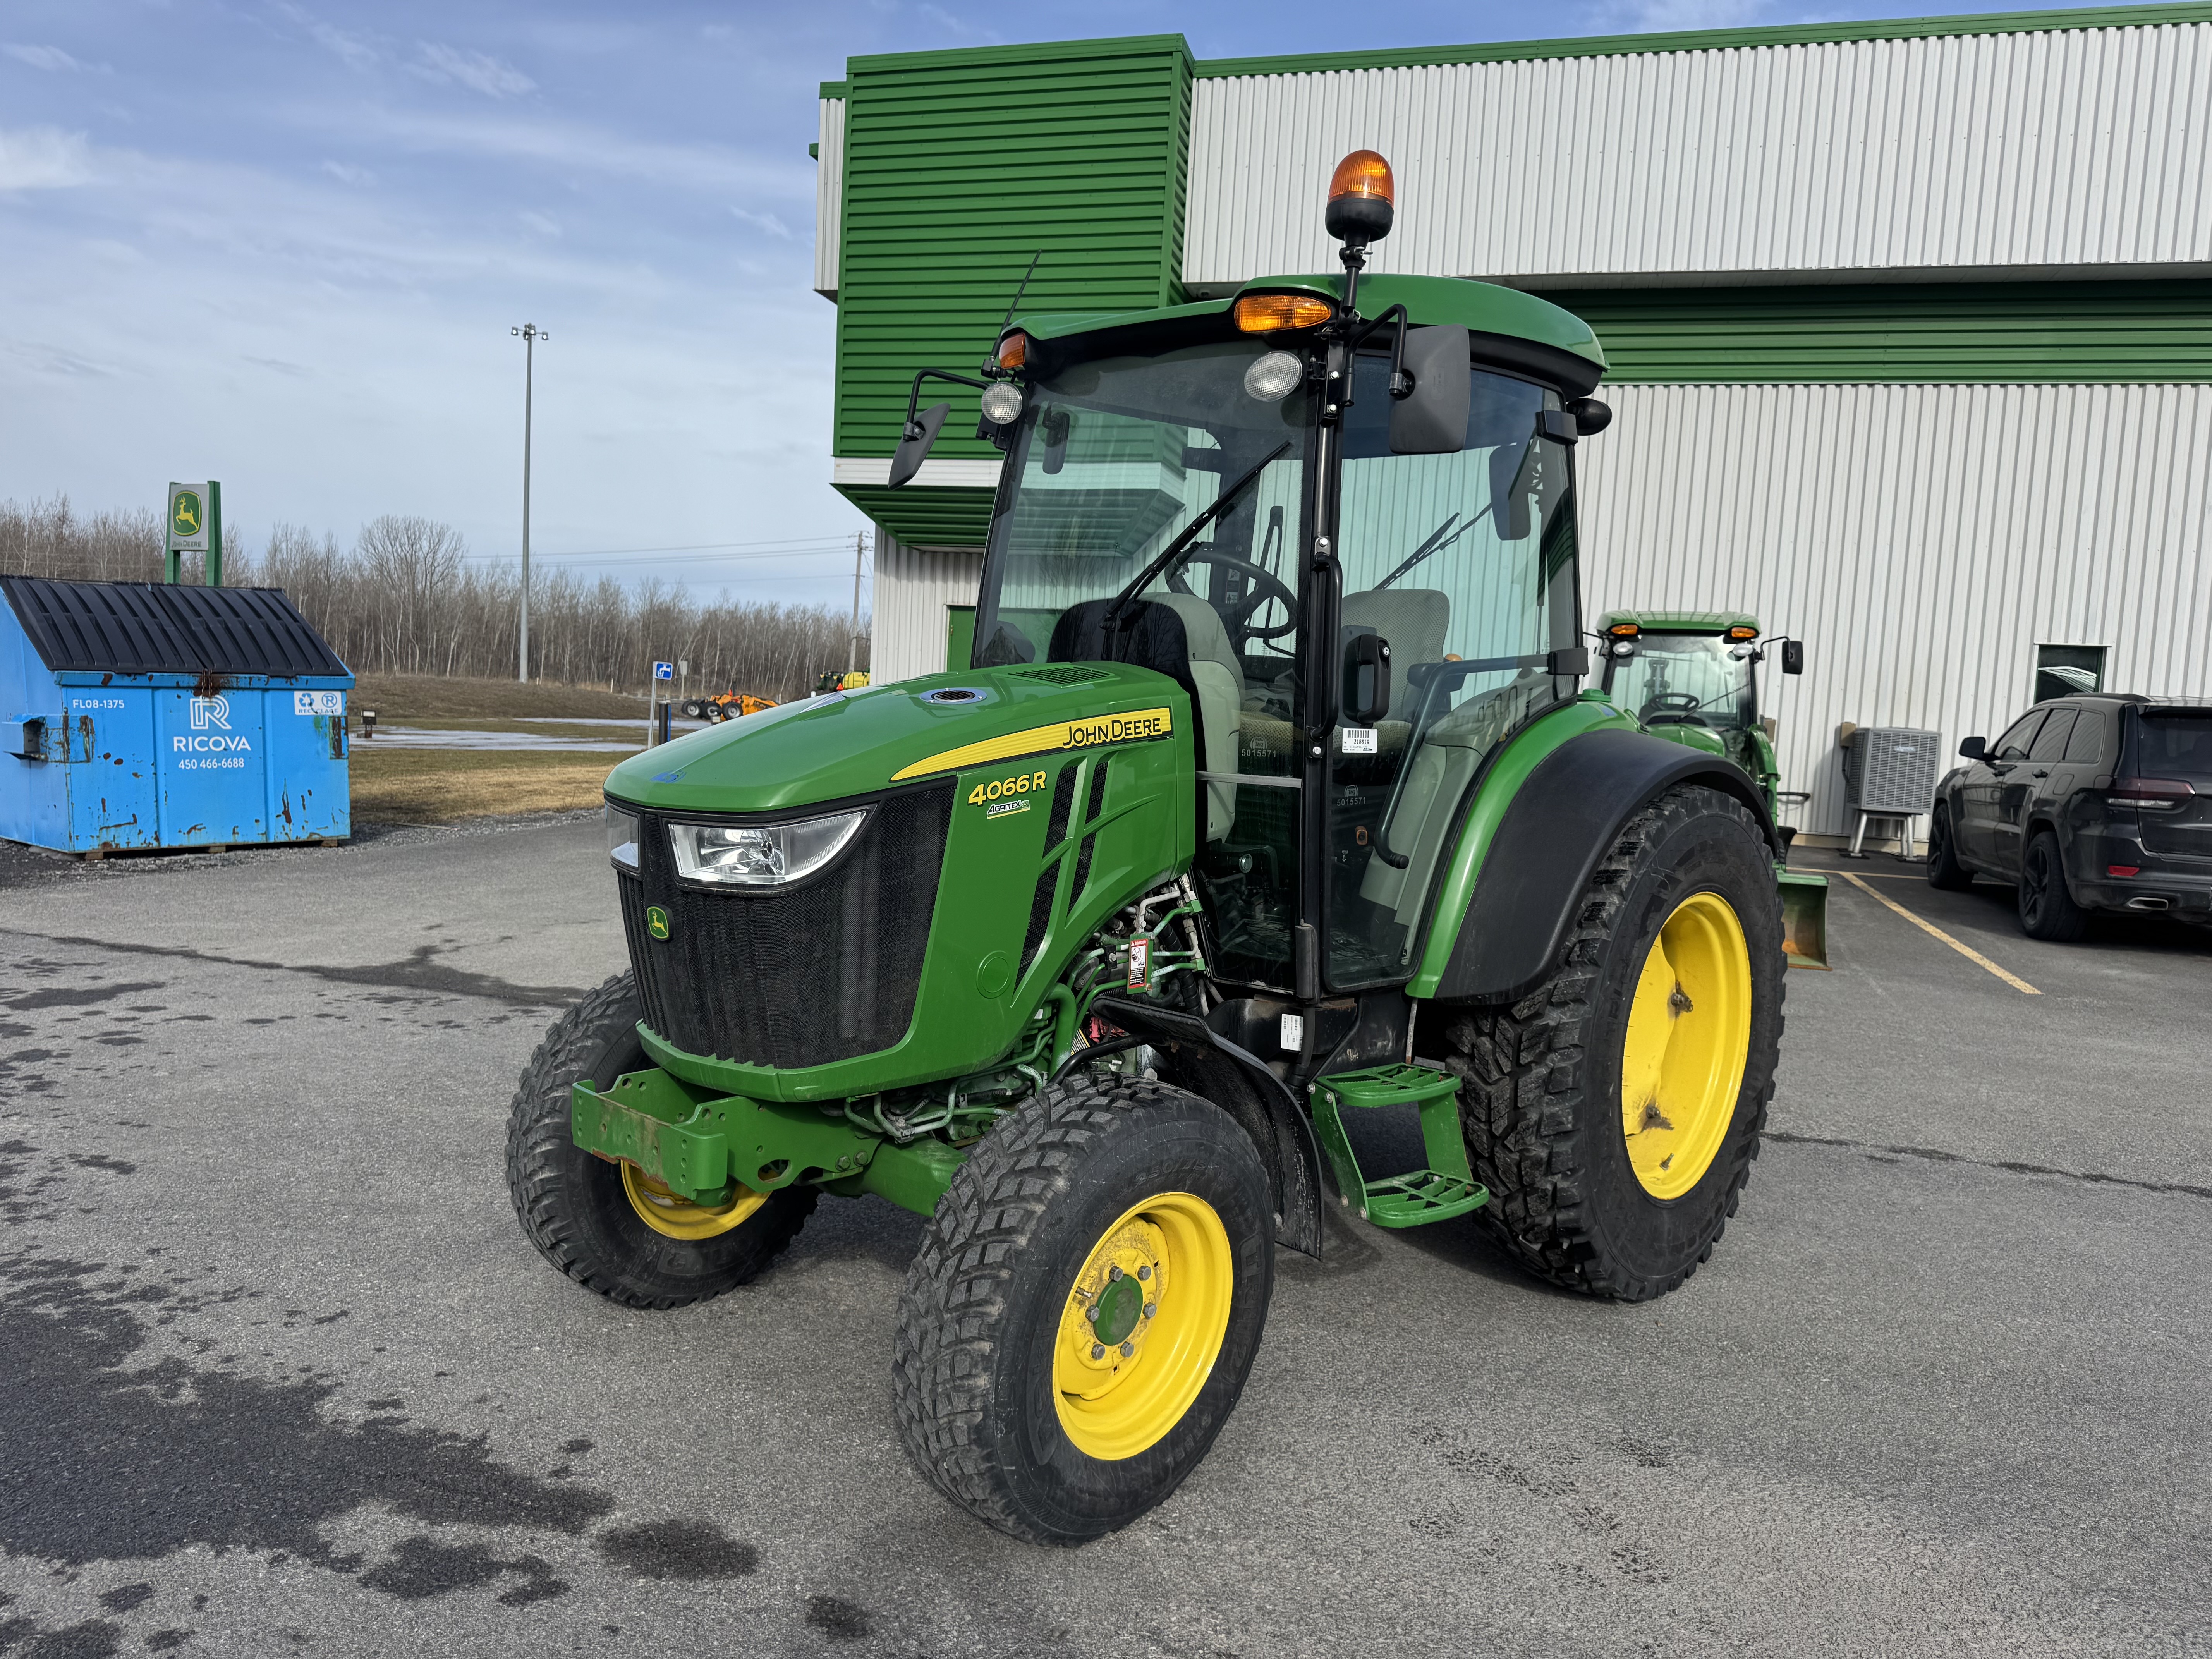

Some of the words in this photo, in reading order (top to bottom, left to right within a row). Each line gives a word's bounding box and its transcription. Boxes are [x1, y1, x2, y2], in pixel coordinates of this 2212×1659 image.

[72, 699, 125, 708] FL08-1375
[1063, 724, 1108, 746] JOHN
[1111, 718, 1161, 738] DEERE
[173, 736, 251, 752] RICOVA
[1241, 749, 1276, 757] 5015571
[178, 759, 197, 770] 450
[200, 757, 244, 769] 466-6688
[988, 801, 1021, 814] AGRITEX
[1337, 797, 1365, 806] 5015571
